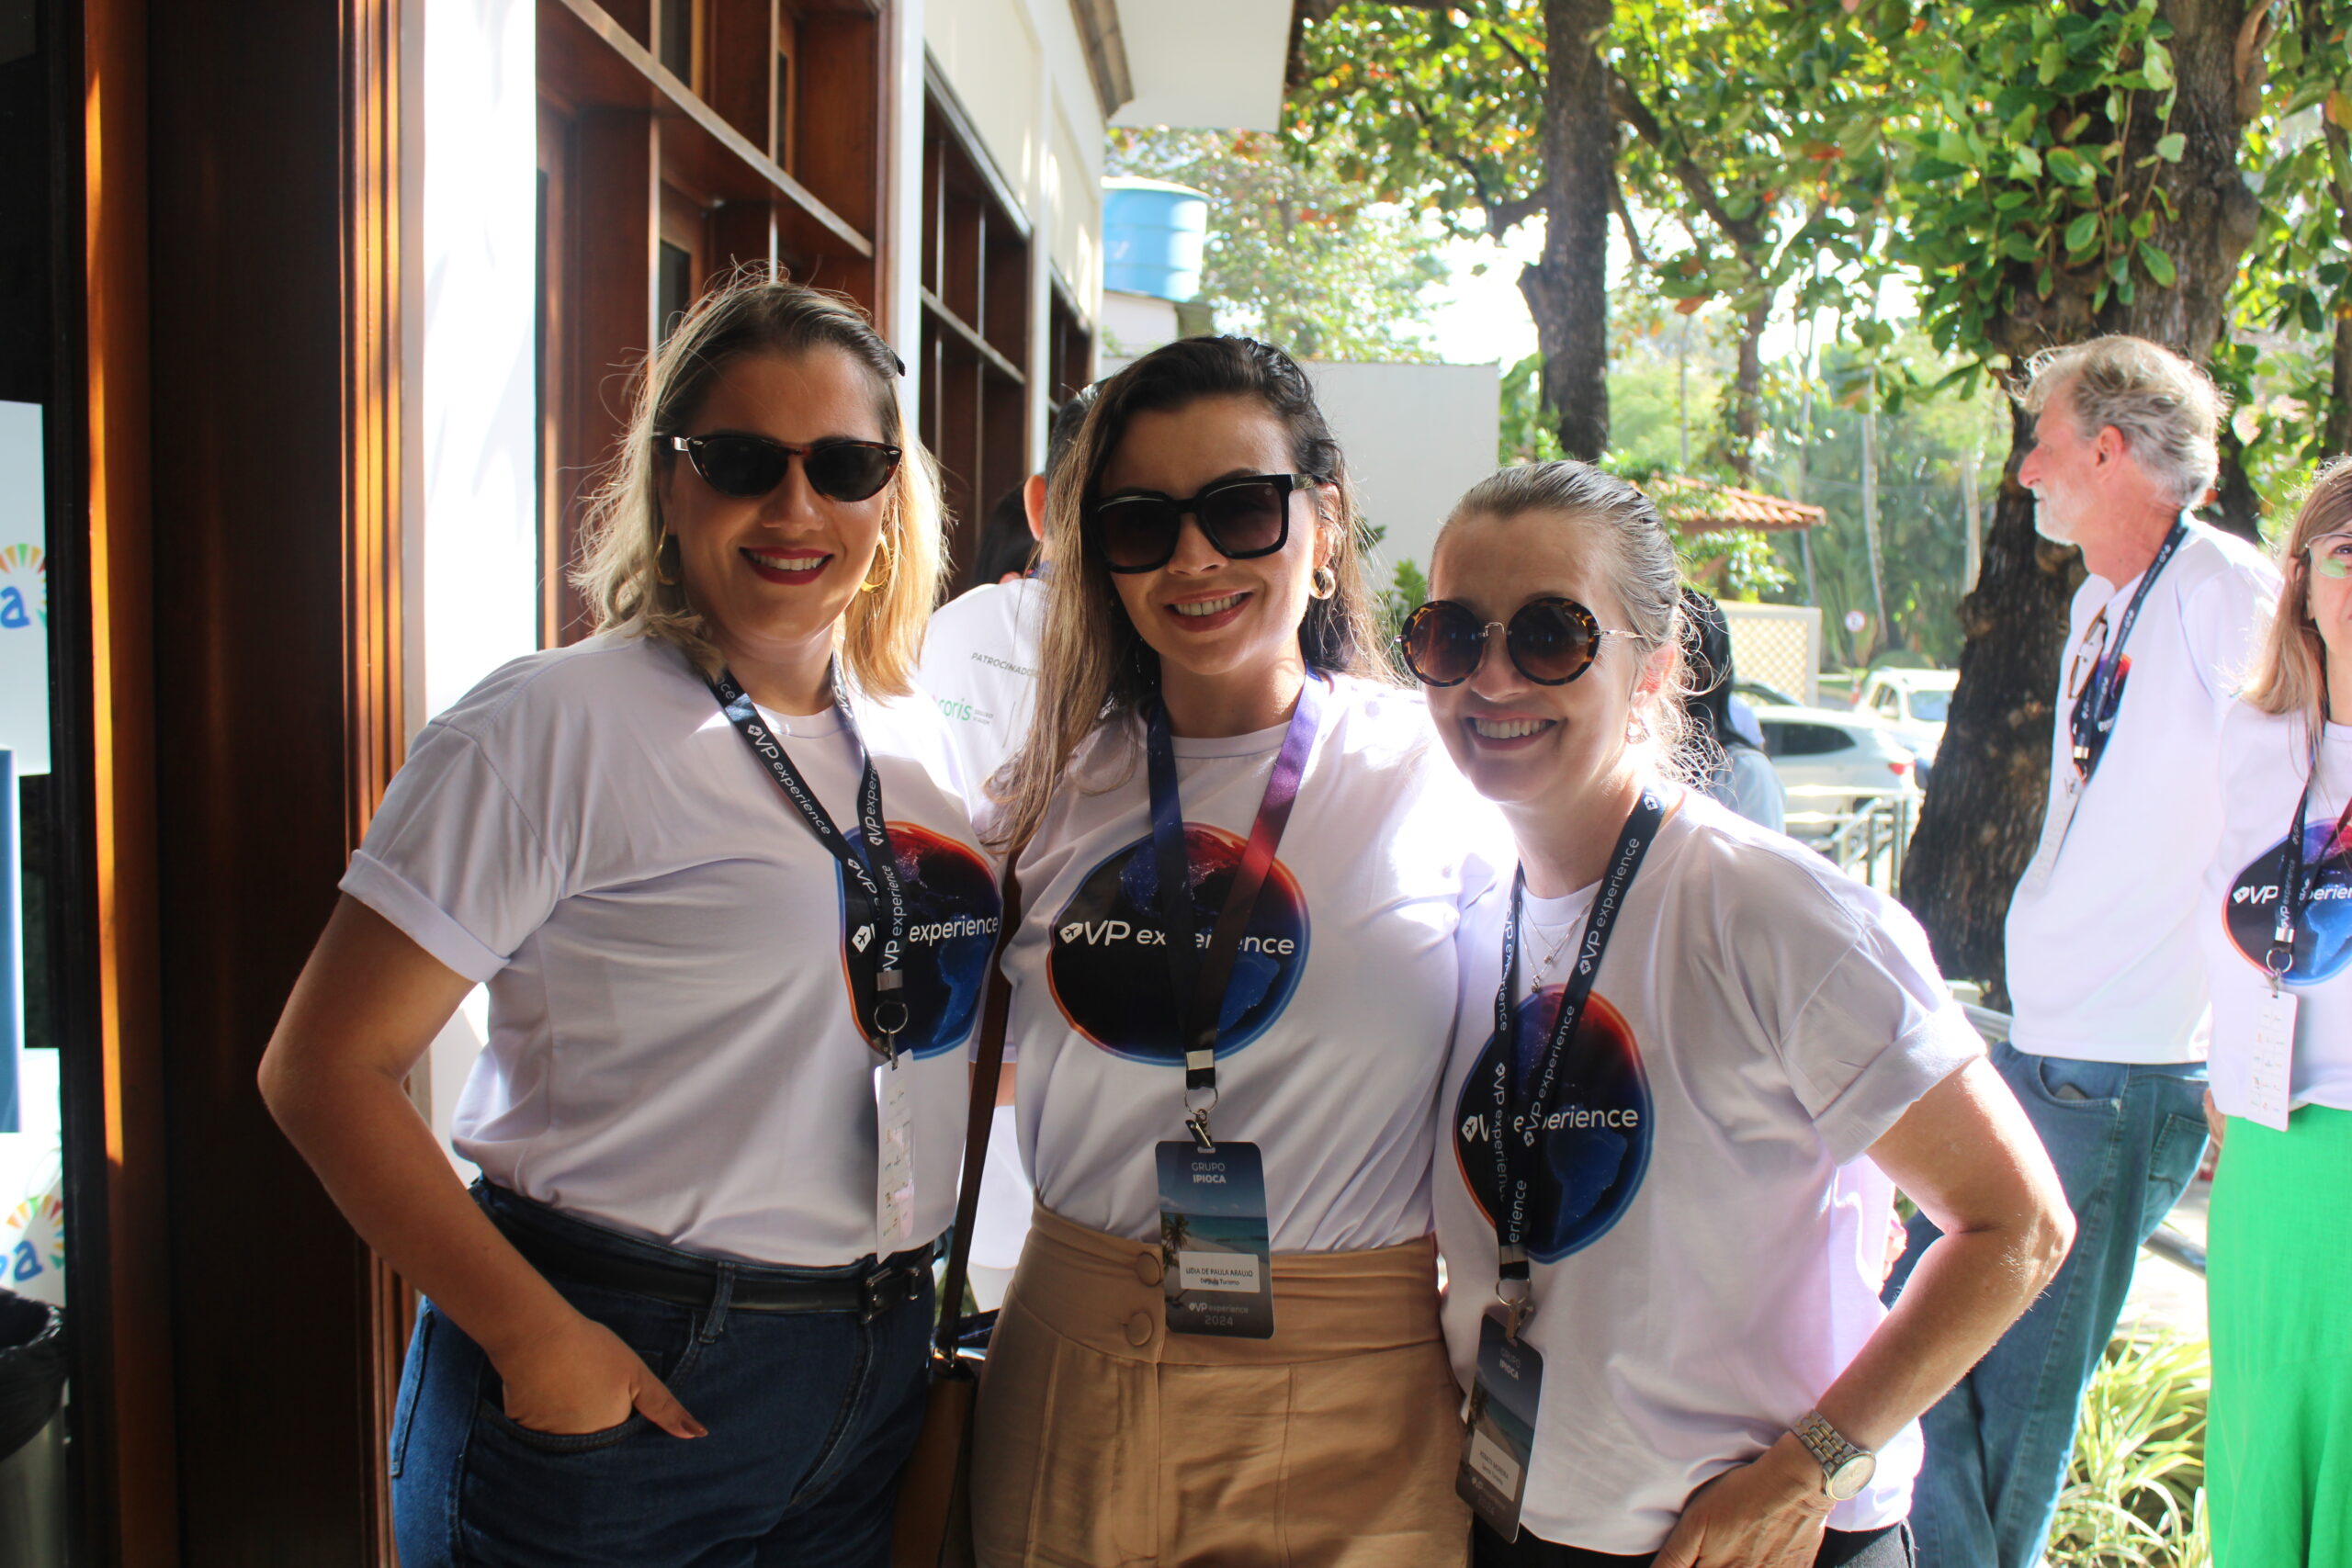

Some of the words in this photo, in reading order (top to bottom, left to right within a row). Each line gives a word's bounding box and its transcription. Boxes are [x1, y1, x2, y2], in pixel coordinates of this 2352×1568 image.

[971, 652, 1038, 678] PATROCINAD
[754, 733, 780, 760] VP
[773, 761, 831, 835] experience
[865, 816, 883, 840] VP
[856, 869, 878, 894] VP
[882, 865, 908, 937] experience
[1582, 930, 1600, 962] VP
[1598, 837, 1640, 929] experience
[2250, 885, 2279, 905] VP
[2309, 885, 2352, 901] erie
[2279, 906, 2291, 924] VP
[909, 916, 999, 947] experience
[1084, 919, 1132, 947] VP
[882, 940, 901, 968] VP
[1526, 1101, 1542, 1132] VP
[1538, 1005, 1575, 1100] experience
[1493, 1076, 1505, 1106] VP
[1191, 1161, 1226, 1172] GRUPO
[1193, 1174, 1227, 1184] IPIOCA
[1210, 1269, 1229, 1277] PAULA
[1204, 1314, 1234, 1327] 2024
